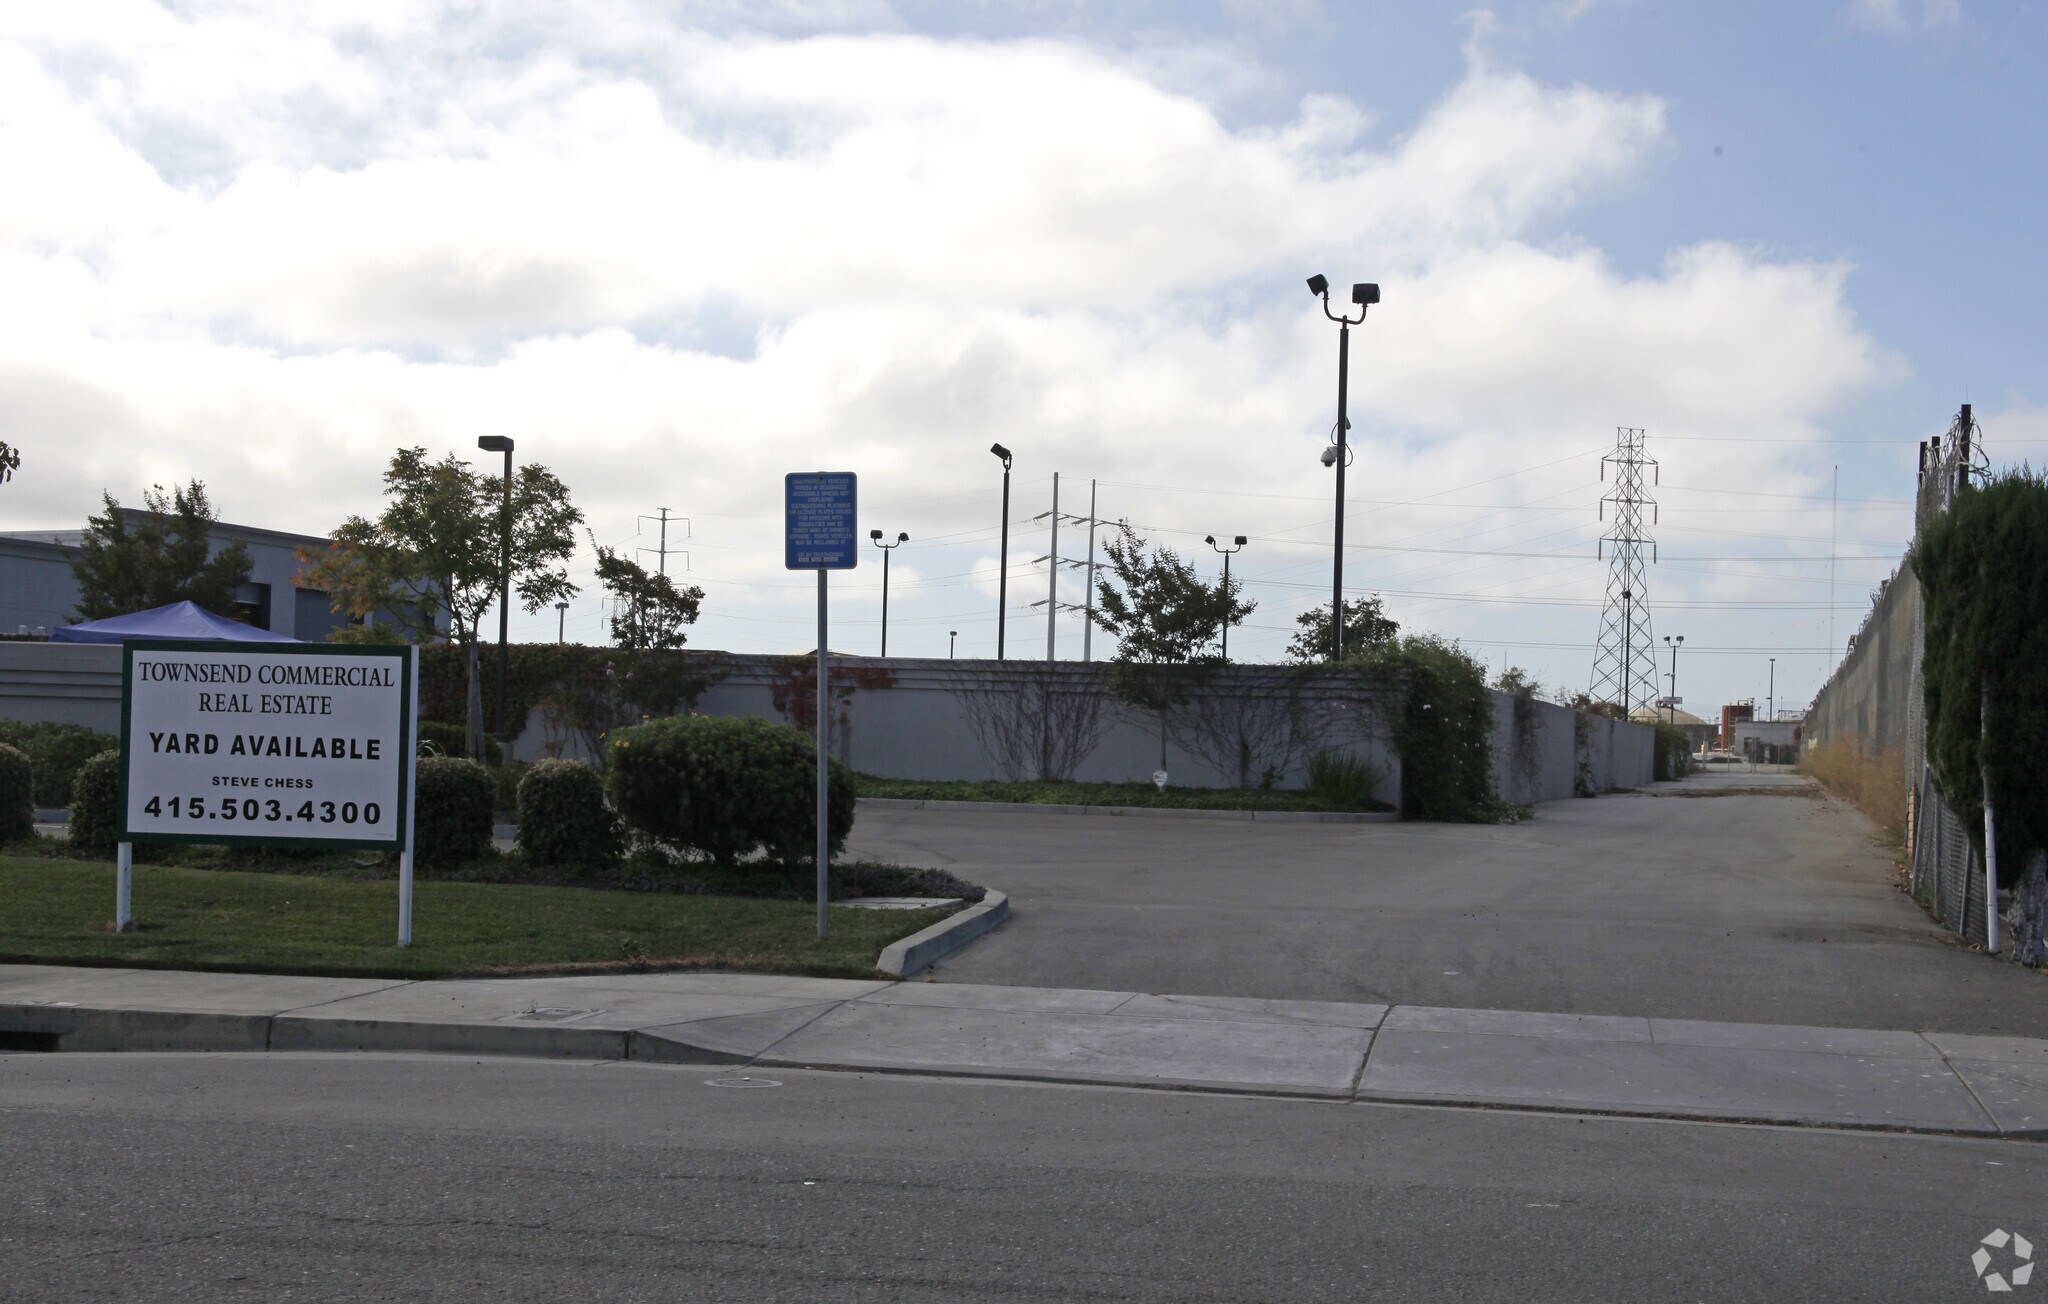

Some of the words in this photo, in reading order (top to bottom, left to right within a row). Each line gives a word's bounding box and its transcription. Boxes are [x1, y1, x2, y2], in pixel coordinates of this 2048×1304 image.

[139, 662, 251, 683] TOWNSEND
[258, 665, 394, 686] COMMERCIAL
[199, 693, 253, 712] REAL
[260, 695, 331, 714] ESTATE
[149, 732, 218, 754] YARD
[230, 735, 380, 760] AVAILABLE
[212, 776, 258, 787] STEVE
[265, 778, 313, 788] CHESS
[145, 796, 380, 824] 415.503.4300
